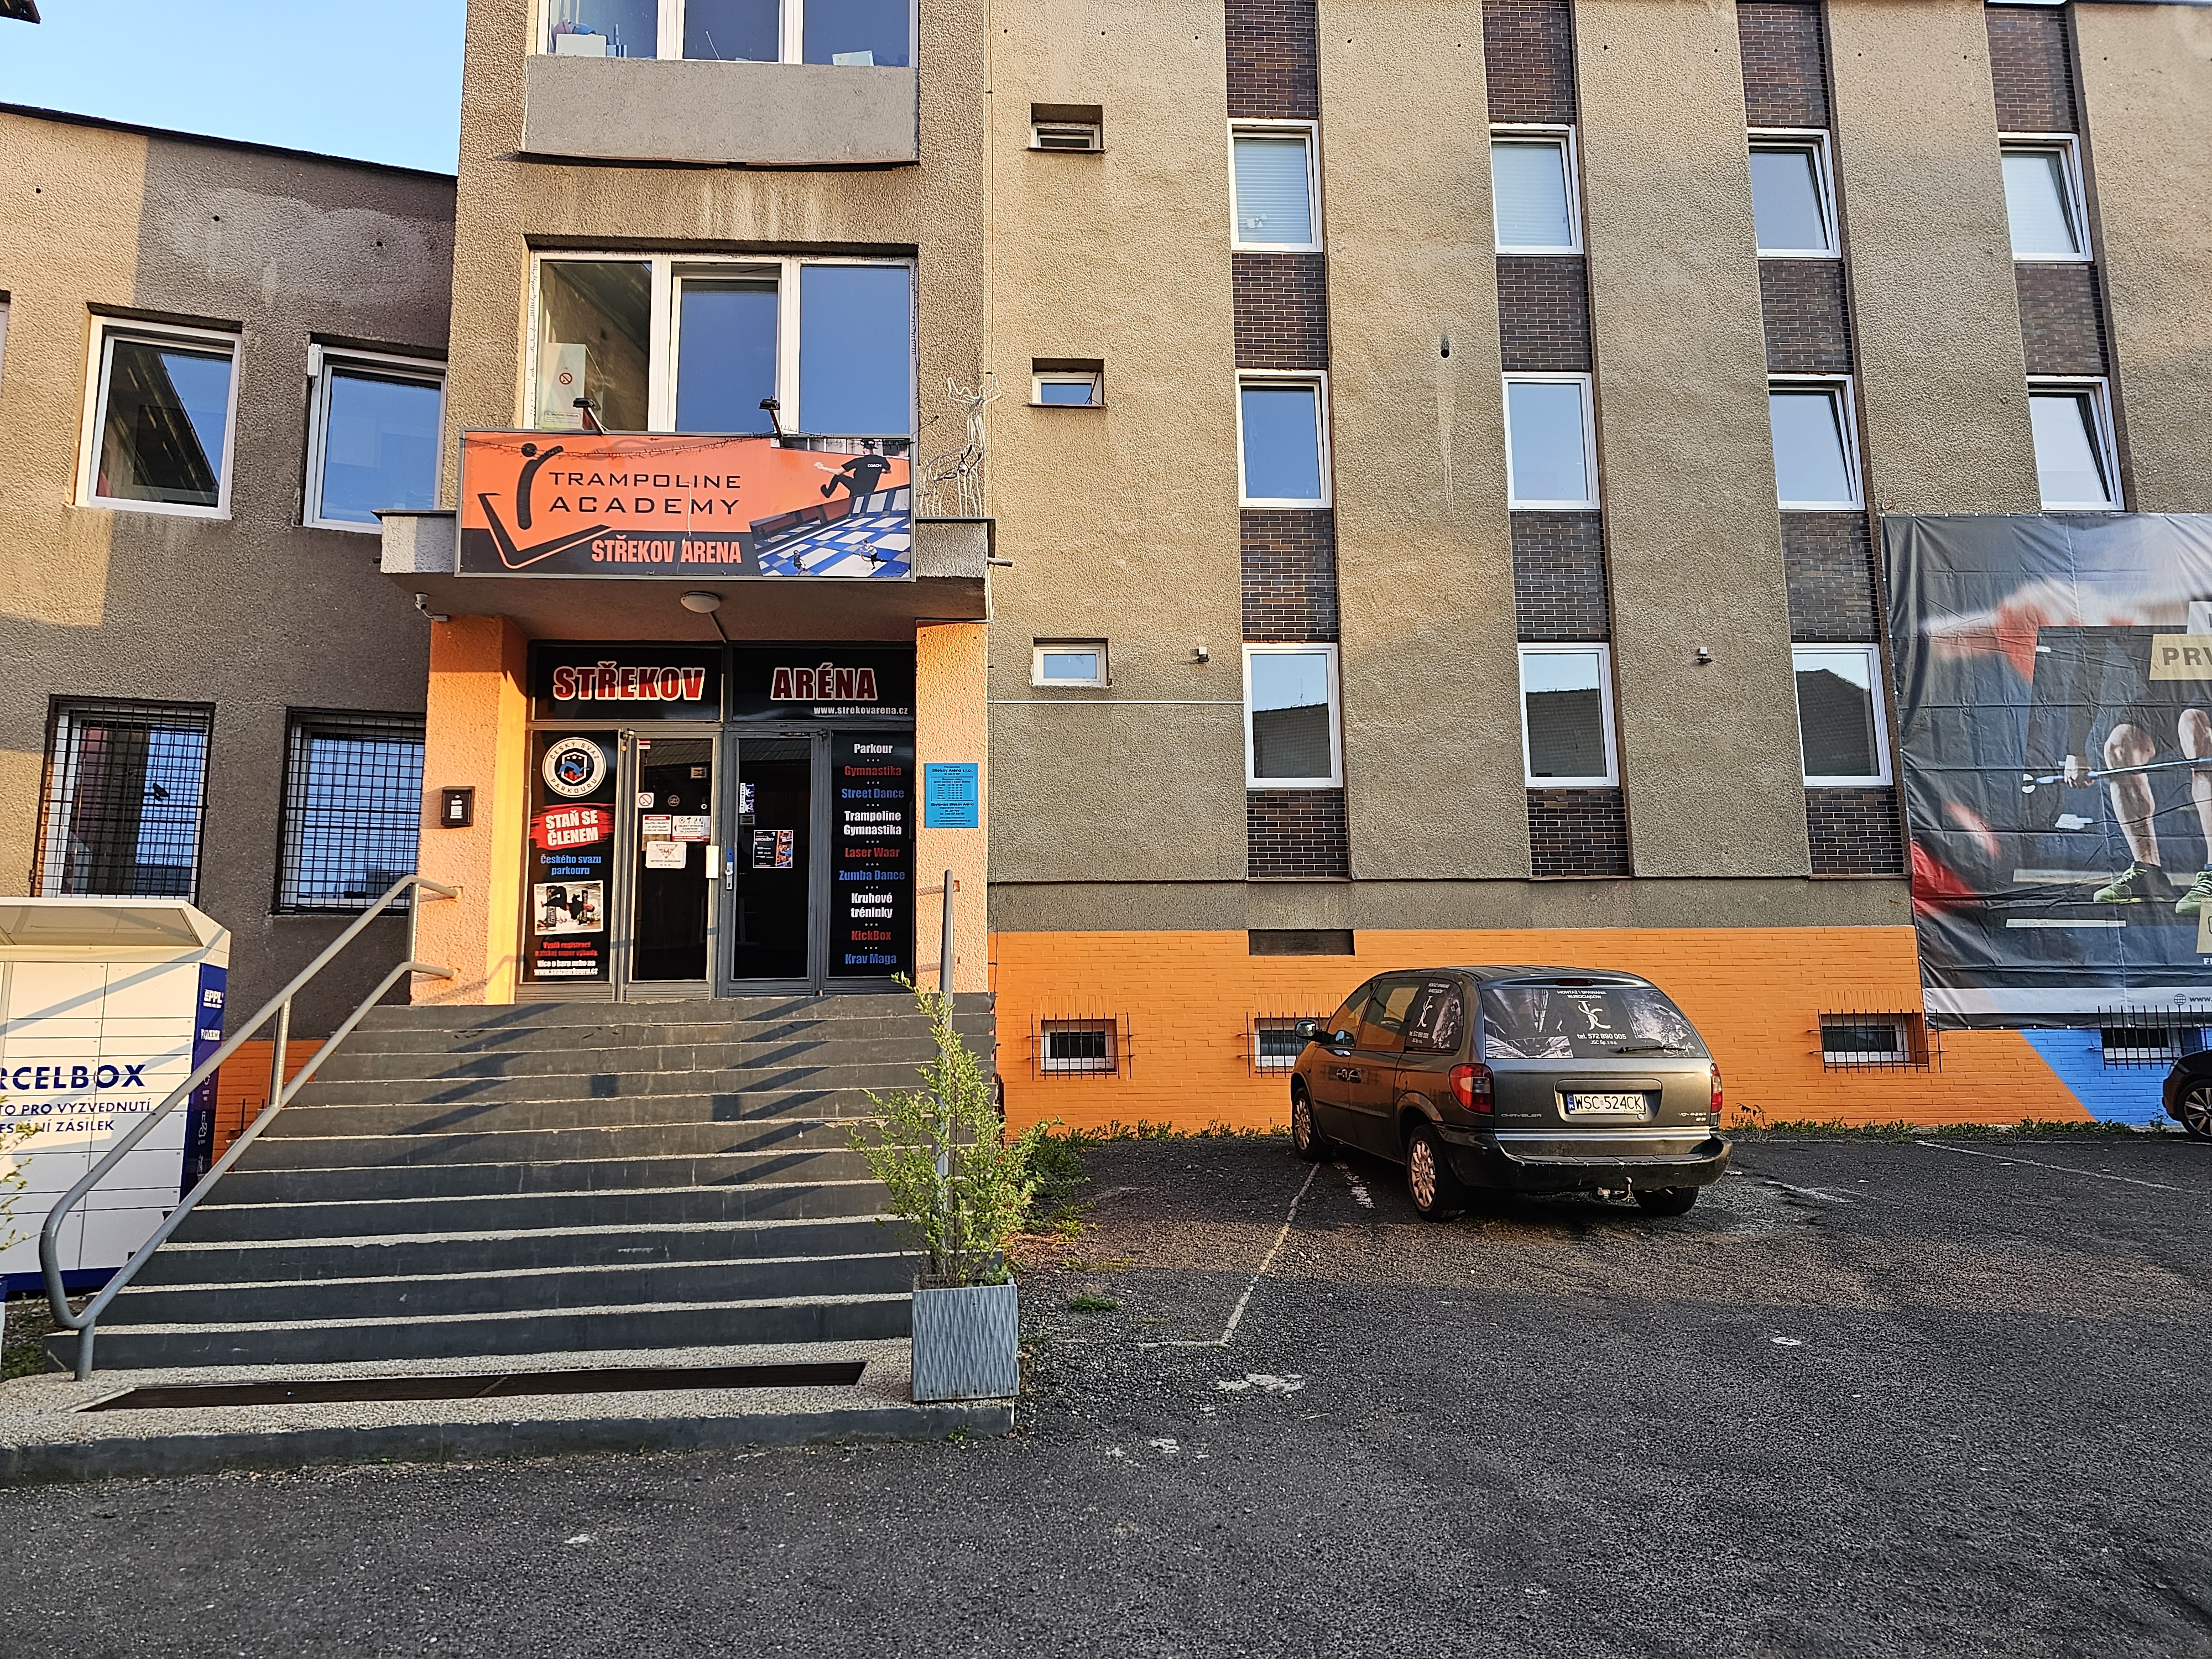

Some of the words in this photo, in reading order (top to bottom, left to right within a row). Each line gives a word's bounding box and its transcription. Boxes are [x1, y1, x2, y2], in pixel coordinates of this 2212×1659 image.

[549, 472, 740, 488] TRAMPOLINE
[549, 496, 740, 515] ACADEMY
[592, 534, 675, 563] STŘEKOV
[680, 540, 742, 564] ARENA
[553, 661, 706, 701] STŘEKOV
[770, 662, 878, 701] ARÉNA
[813, 706, 909, 714] www.strekovarena.cz
[549, 741, 576, 760] ČESKÝ
[581, 743, 599, 760] SVAZ
[854, 743, 893, 754] Parkour
[844, 765, 902, 776] Gymnastika
[550, 778, 597, 794] PARKOURU
[841, 788, 872, 799] Street
[874, 788, 905, 799] Dance
[545, 810, 580, 830] STAŇ
[581, 810, 598, 825] SE
[844, 811, 901, 822] Trampoline
[843, 825, 902, 836] Gymnastika
[547, 827, 599, 846] ČLENEM
[845, 848, 872, 857] Laser
[874, 848, 900, 857] Waar
[540, 853, 577, 864] Českého
[551, 867, 590, 876] parkouru
[838, 870, 872, 880] Zumba
[874, 870, 905, 880] Dance
[851, 893, 893, 904] Kruhové
[851, 907, 893, 918] tréninky
[851, 930, 891, 940] KickBox
[845, 953, 868, 964] Krav
[870, 953, 897, 965] Maga
[21, 1103, 53, 1115] PRO
[57, 1097, 152, 1113] VYZVEDNUTÍ
[1574, 1095, 1600, 1109] WSC
[1604, 1095, 1643, 1110] 524CK
[55, 1118, 115, 1132] ZÁSILEK
